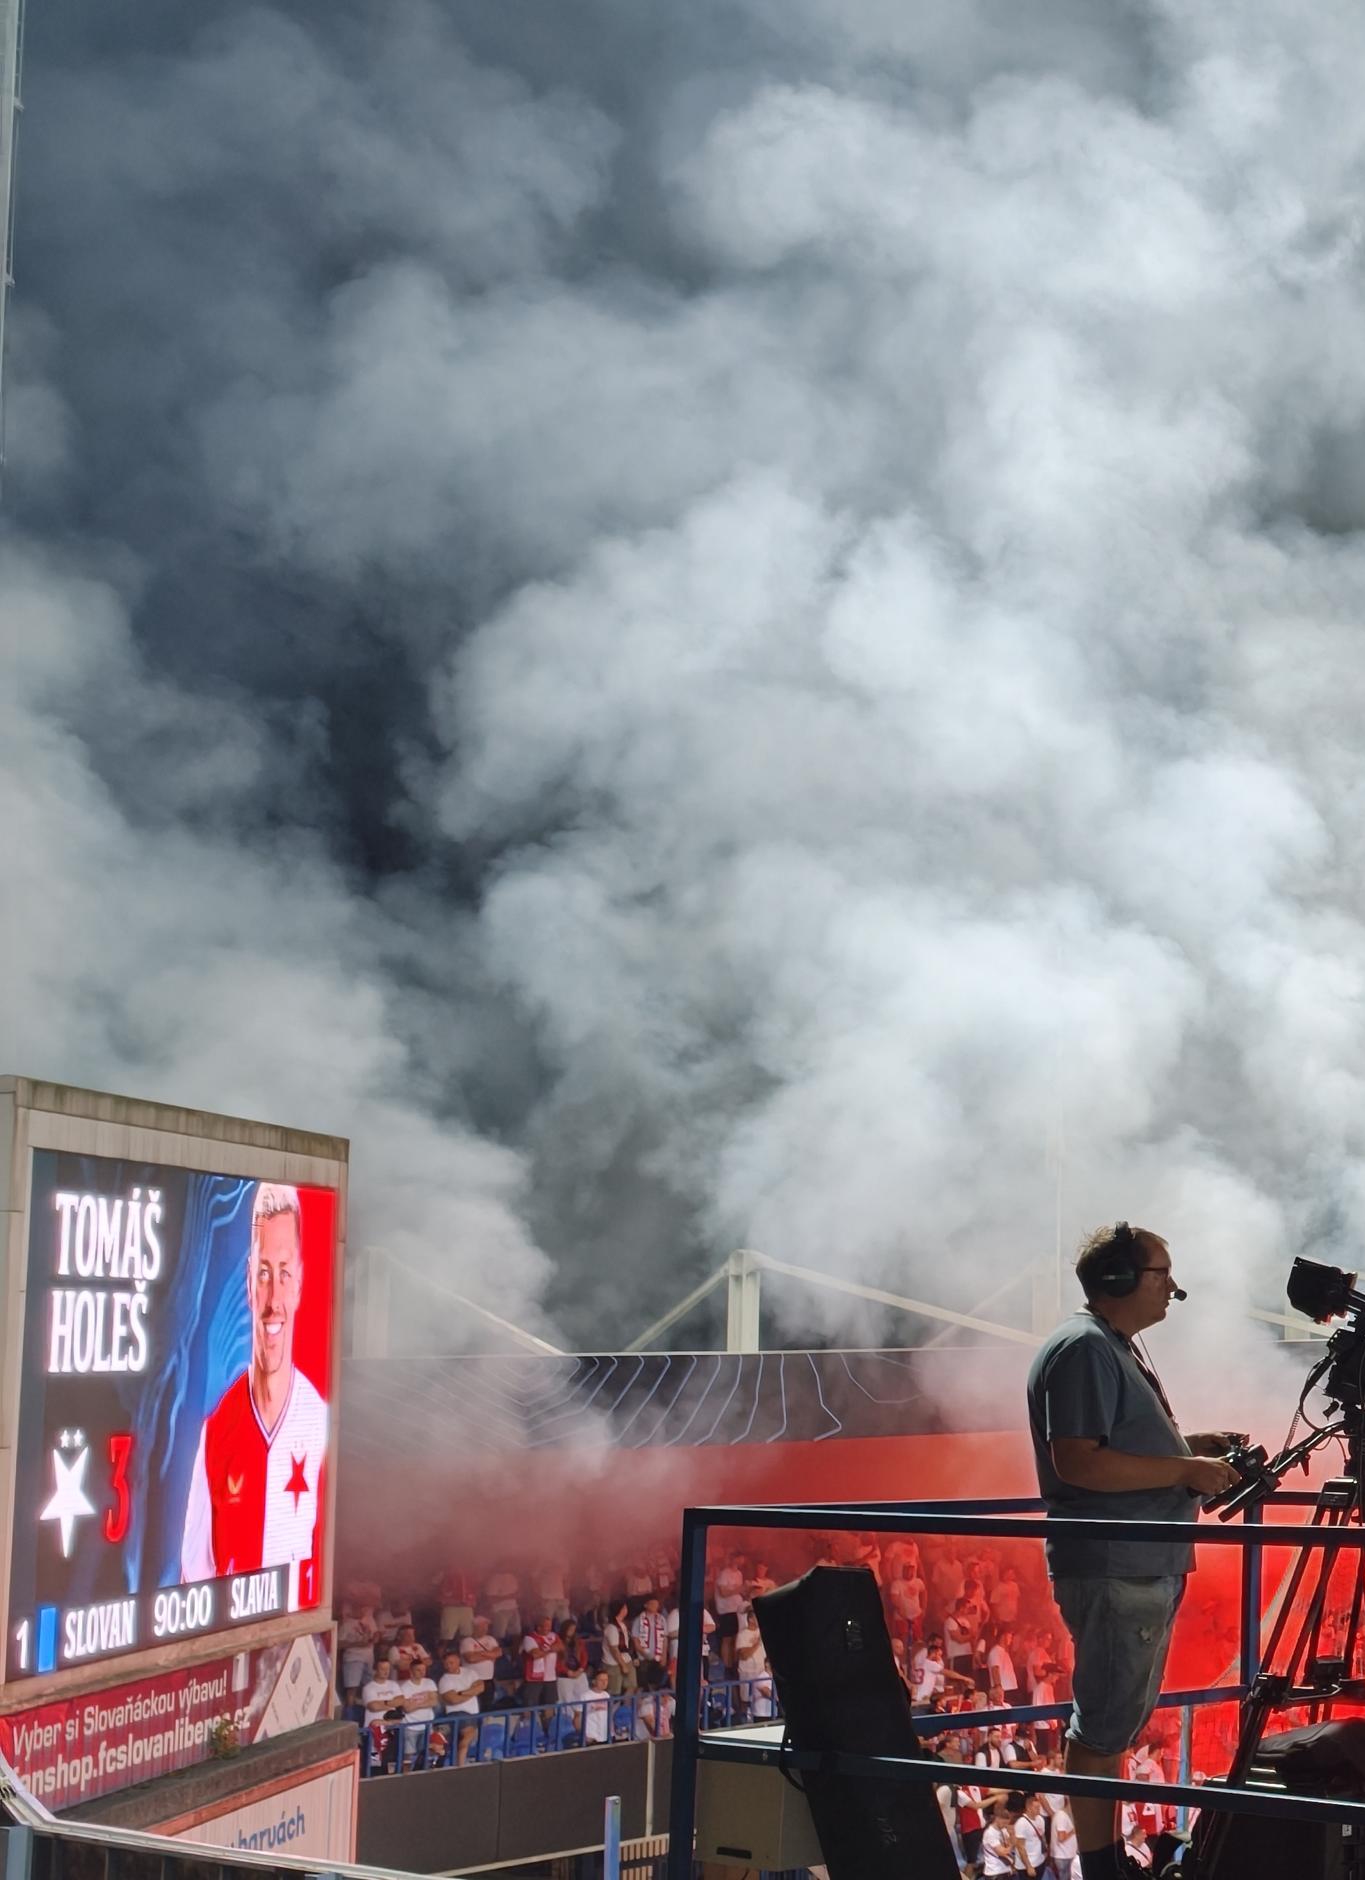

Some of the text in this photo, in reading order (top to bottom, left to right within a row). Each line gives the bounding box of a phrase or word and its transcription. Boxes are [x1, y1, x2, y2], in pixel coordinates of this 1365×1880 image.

[56, 1187, 162, 1281] TOMÁŠ
[48, 1280, 149, 1374] HOLEŠ
[105, 1436, 132, 1542] 3
[16, 1564, 313, 1669] 1 SLOVAN 90:00 SLAVIA 1
[13, 1719, 61, 1761] Vyber
[65, 1710, 80, 1741] si
[83, 1689, 175, 1736] Slovaňáckou
[178, 1670, 228, 1719] výbavu!
[14, 1705, 251, 1796] anshop.fcslovanlibere.cz
